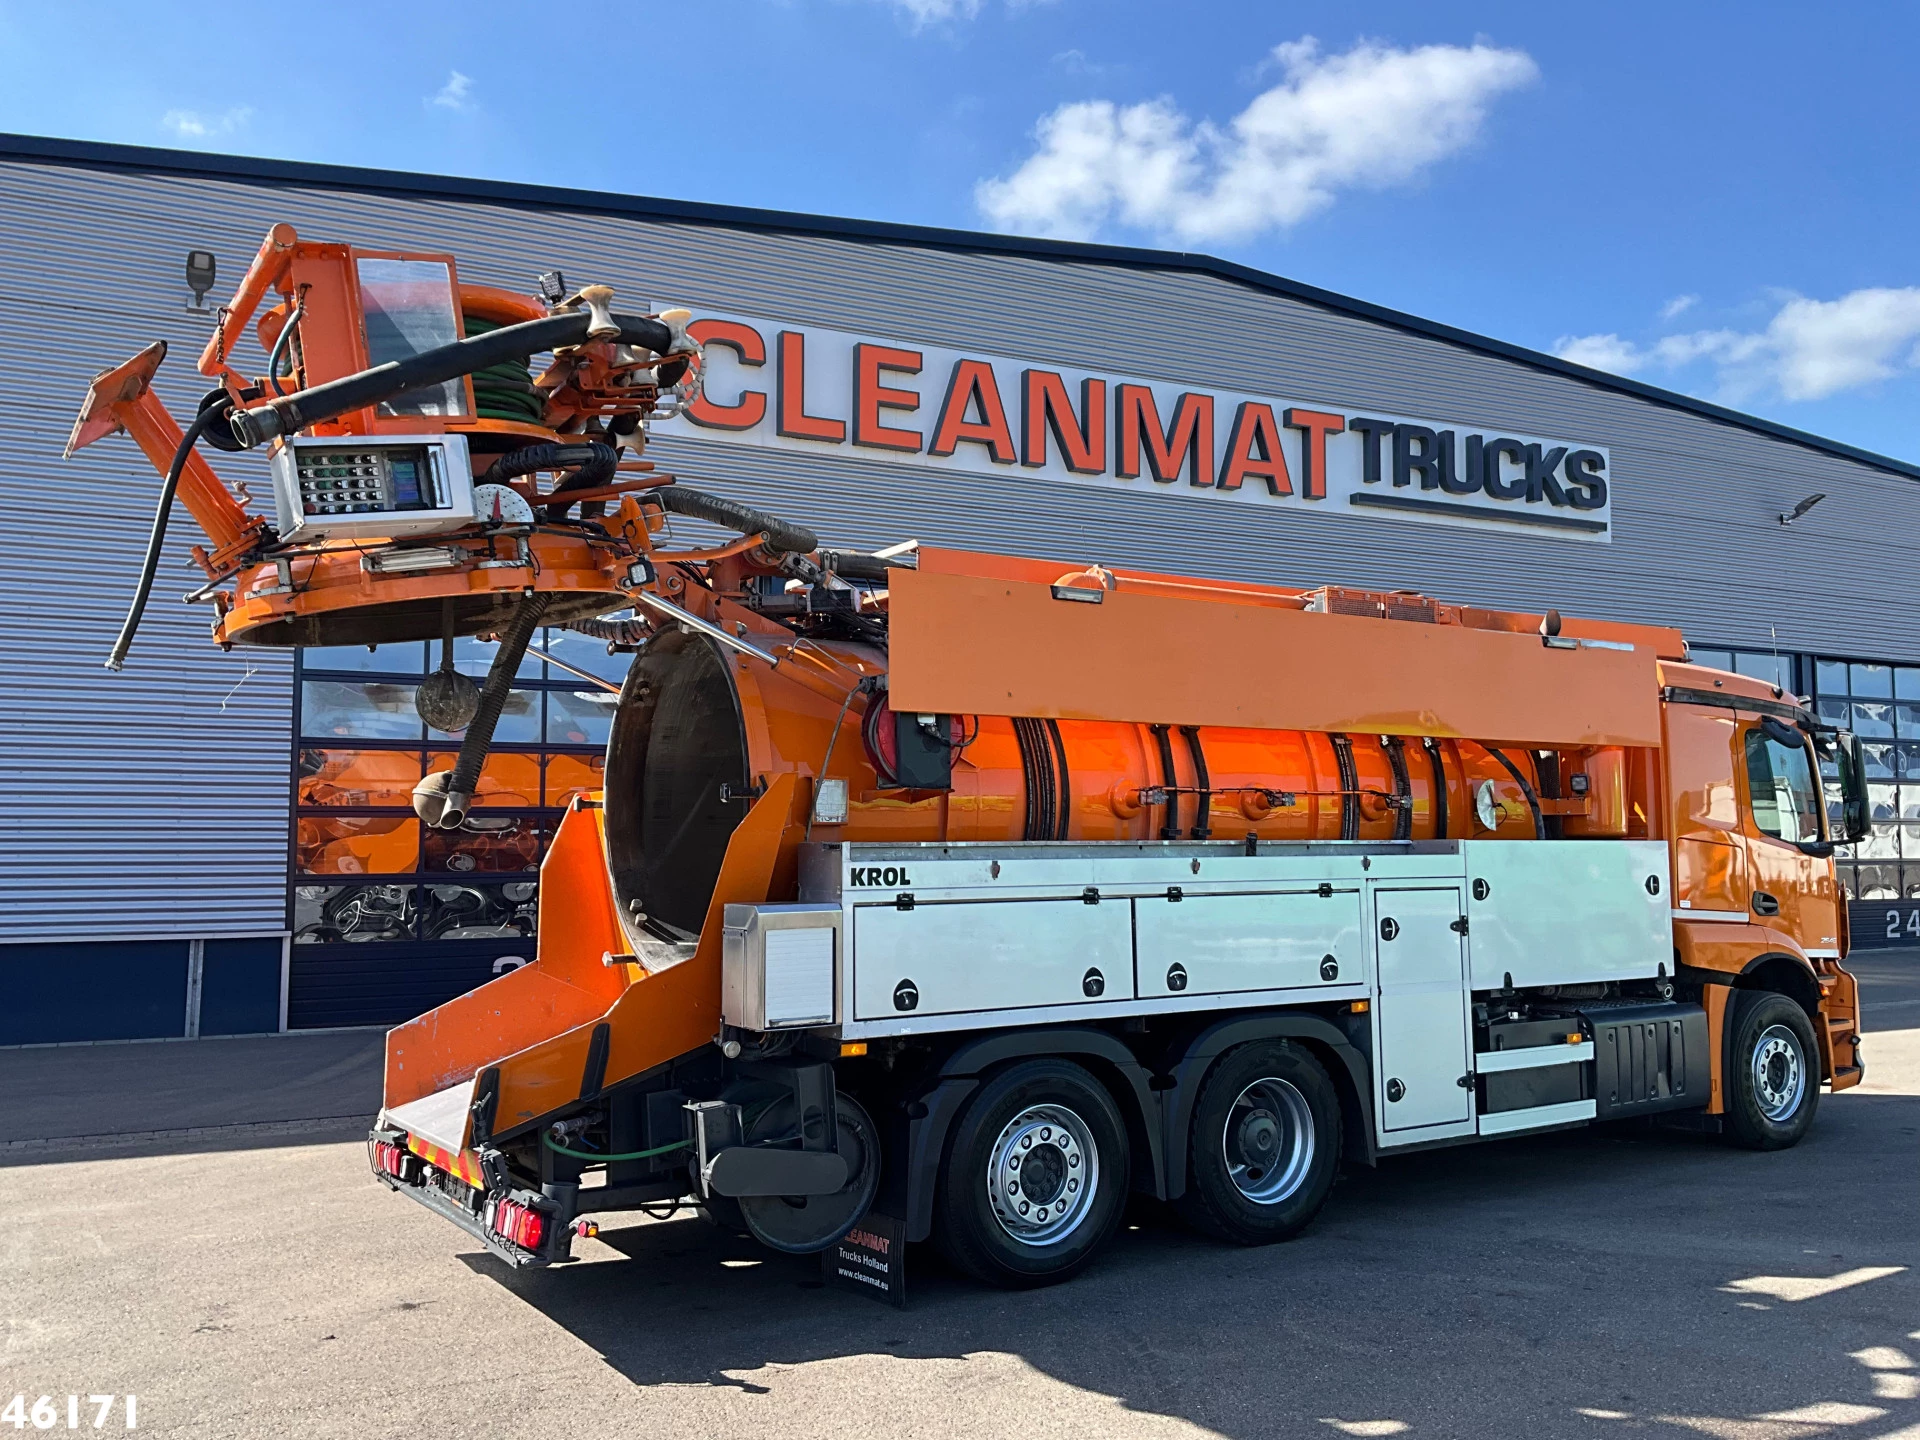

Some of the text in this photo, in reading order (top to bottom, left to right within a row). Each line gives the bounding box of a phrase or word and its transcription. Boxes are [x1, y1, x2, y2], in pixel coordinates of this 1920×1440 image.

[680, 318, 1608, 509] CLEANMAT TRUCKS
[850, 866, 912, 887] KROL
[1886, 909, 1920, 938] 24
[839, 1247, 888, 1272] Trucks Holland
[838, 1267, 888, 1290] www.cleanmat.eu
